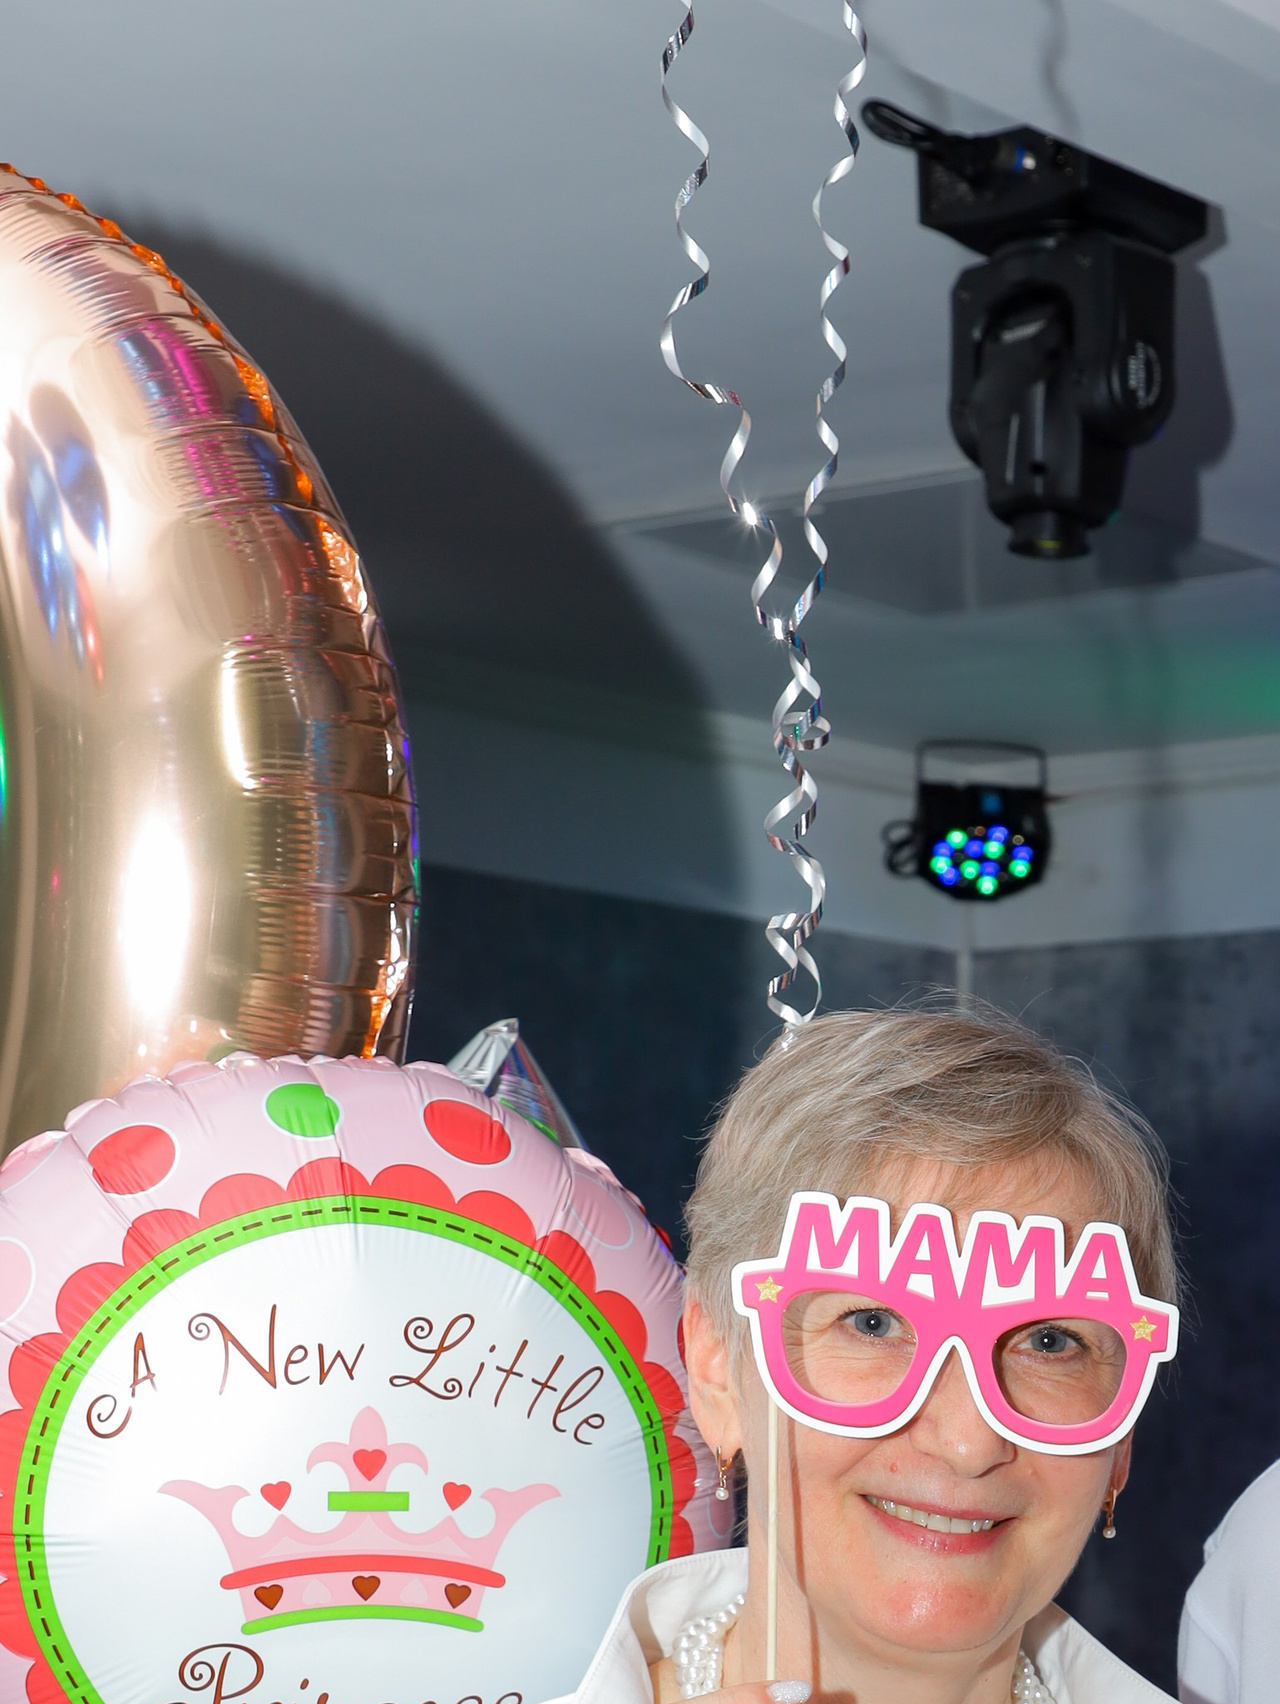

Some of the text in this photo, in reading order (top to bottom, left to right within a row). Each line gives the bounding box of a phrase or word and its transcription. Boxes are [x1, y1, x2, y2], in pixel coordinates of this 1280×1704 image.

[783, 1202, 1138, 1310] МАМА
[86, 1303, 606, 1446] A New Little
